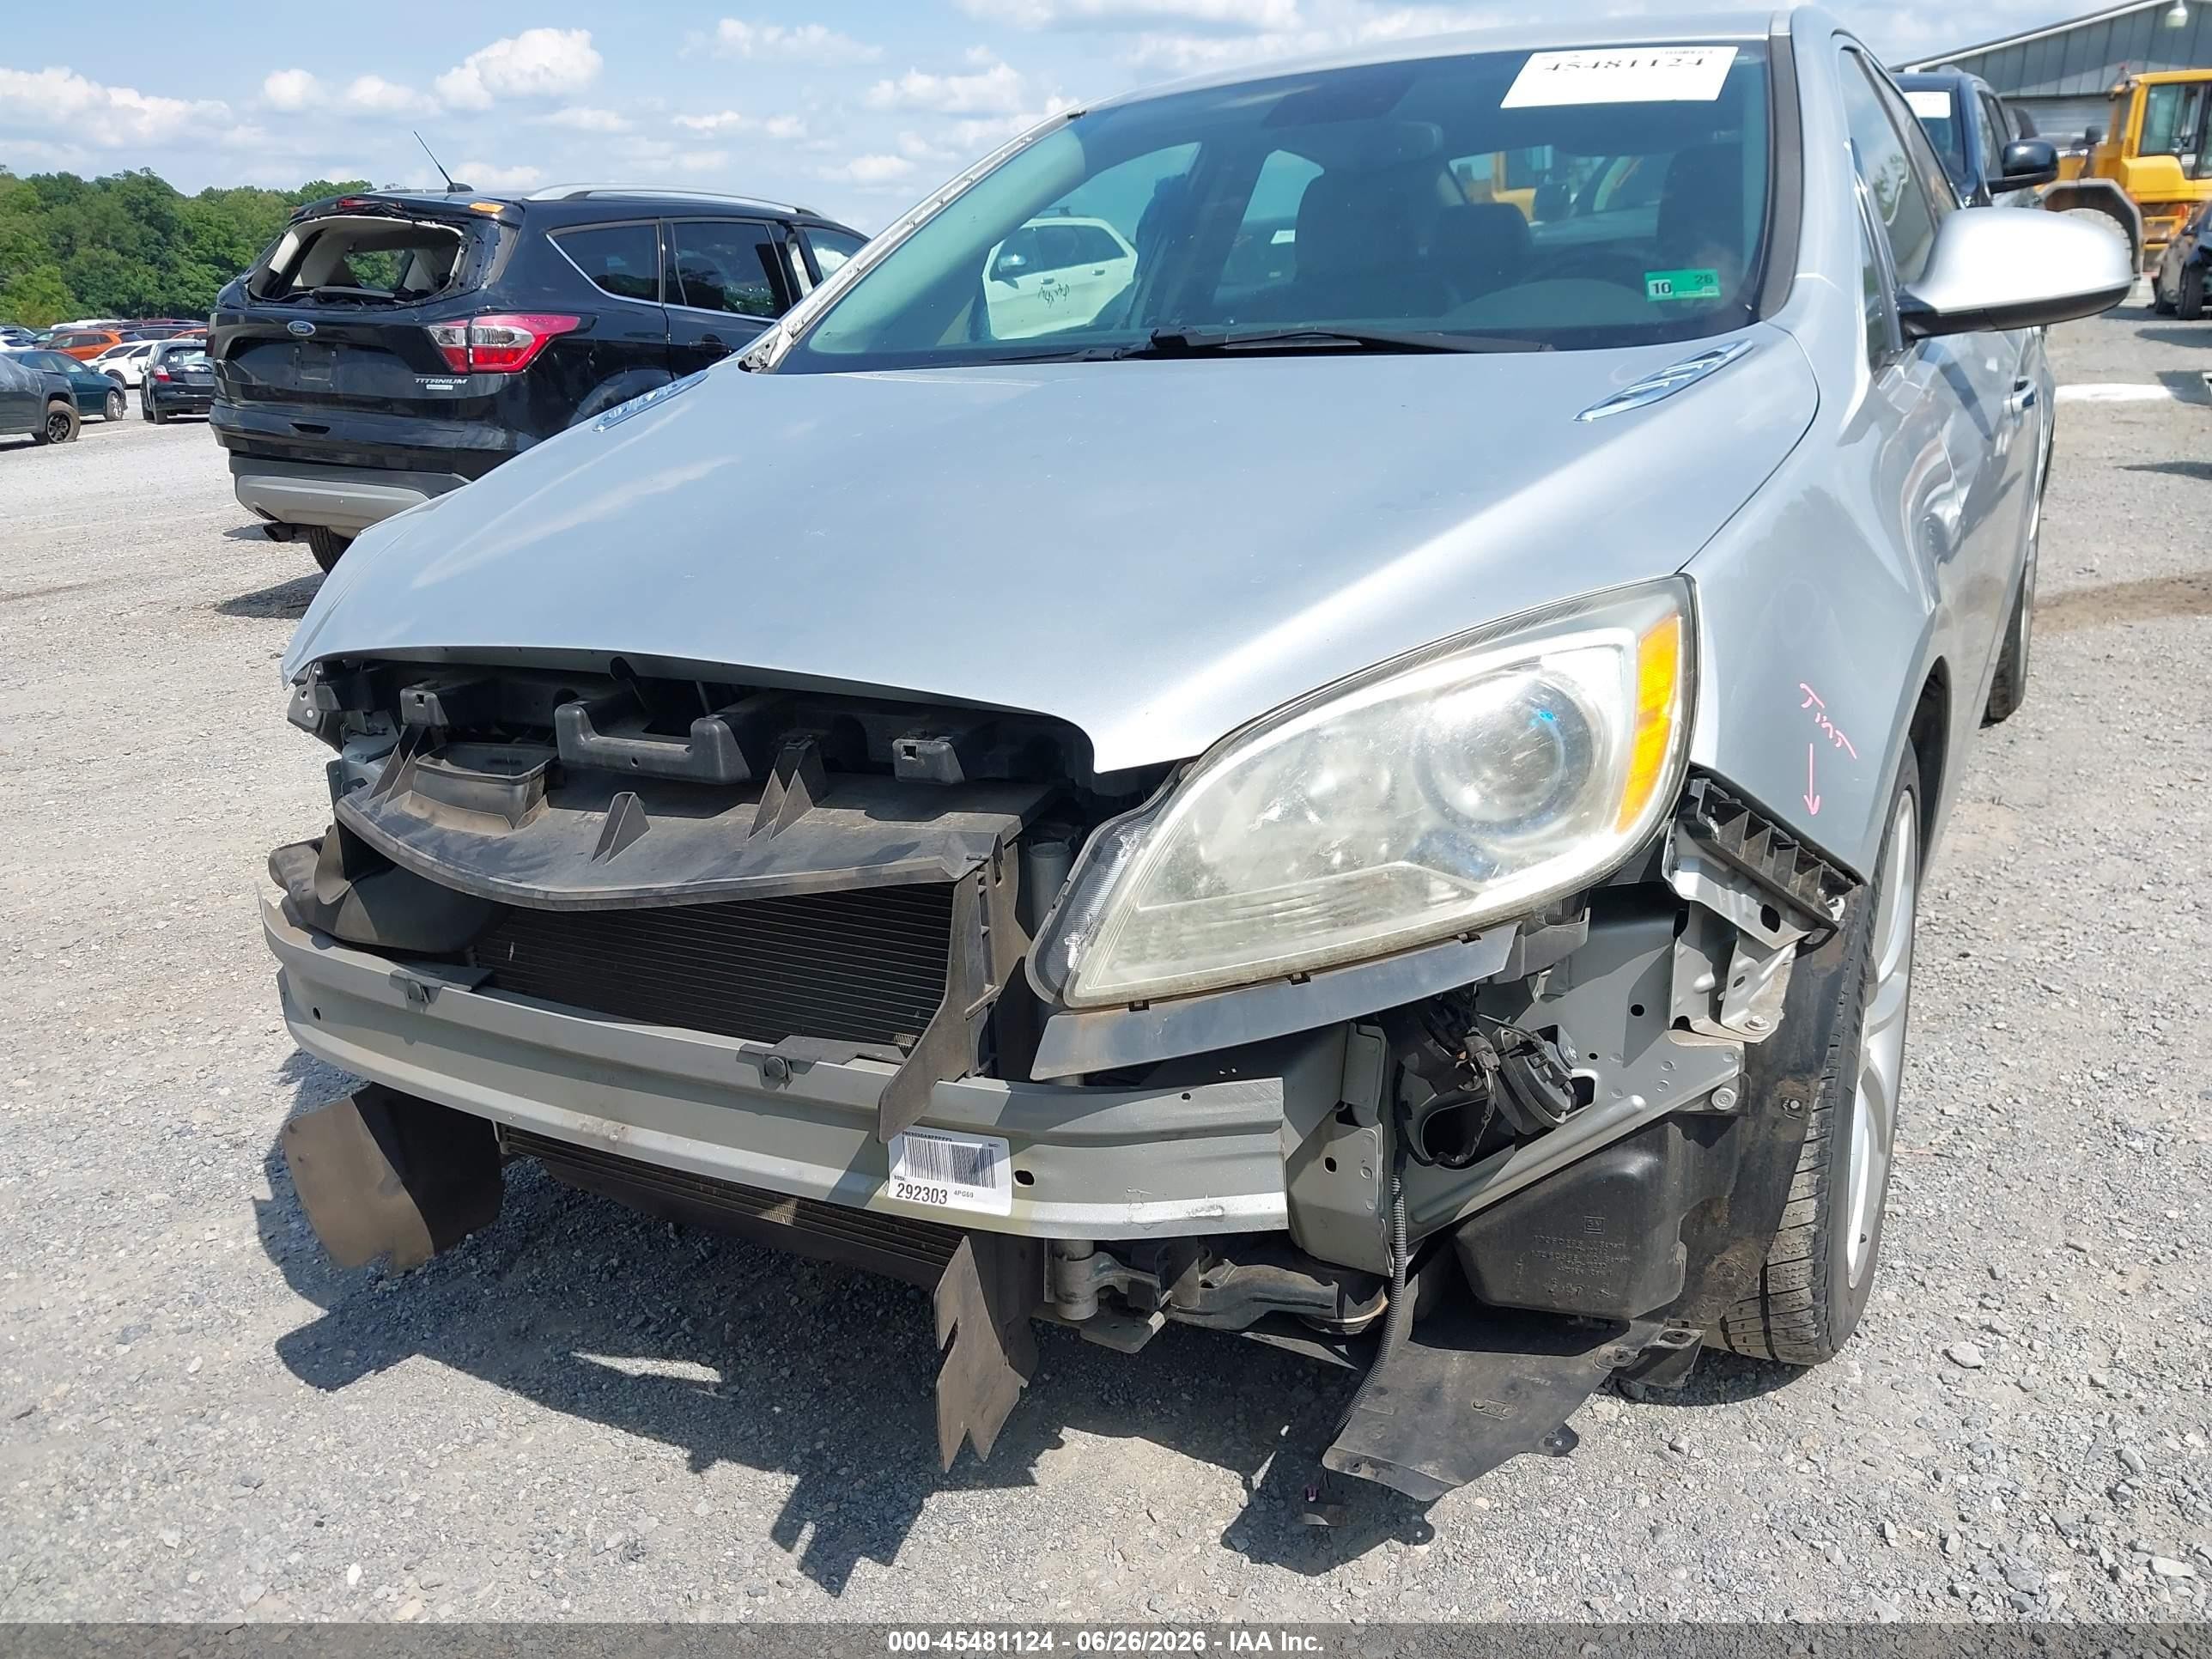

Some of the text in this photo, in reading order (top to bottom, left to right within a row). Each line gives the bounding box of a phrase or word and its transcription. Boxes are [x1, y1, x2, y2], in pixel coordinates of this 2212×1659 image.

[1543, 58, 1705, 71] 45481124
[1652, 282, 1672, 295] 10
[896, 1182, 948, 1205] 292303
